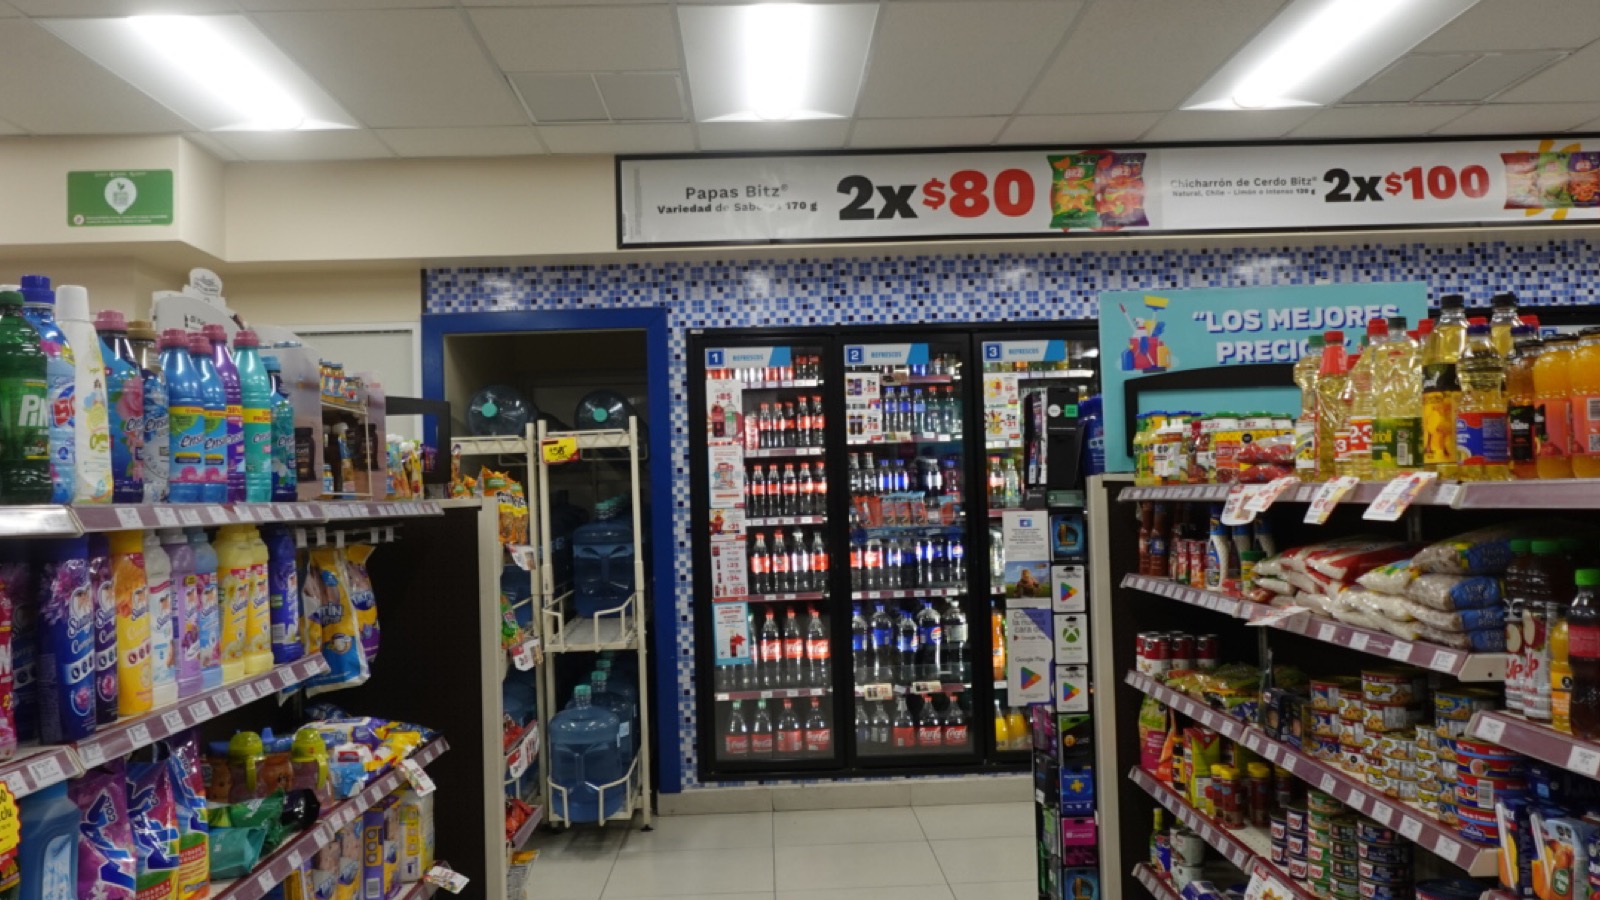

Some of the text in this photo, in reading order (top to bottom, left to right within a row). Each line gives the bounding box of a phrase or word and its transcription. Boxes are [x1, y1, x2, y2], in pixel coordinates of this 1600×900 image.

[1236, 178, 1250, 187] de
[1253, 177, 1287, 187] Cerdo
[685, 186, 739, 202] Papas
[657, 204, 712, 214] Variedad
[786, 201, 807, 210] 170
[810, 202, 818, 212] g
[851, 350, 860, 360] 2
[989, 347, 997, 357] 3
[711, 353, 718, 363] 1
